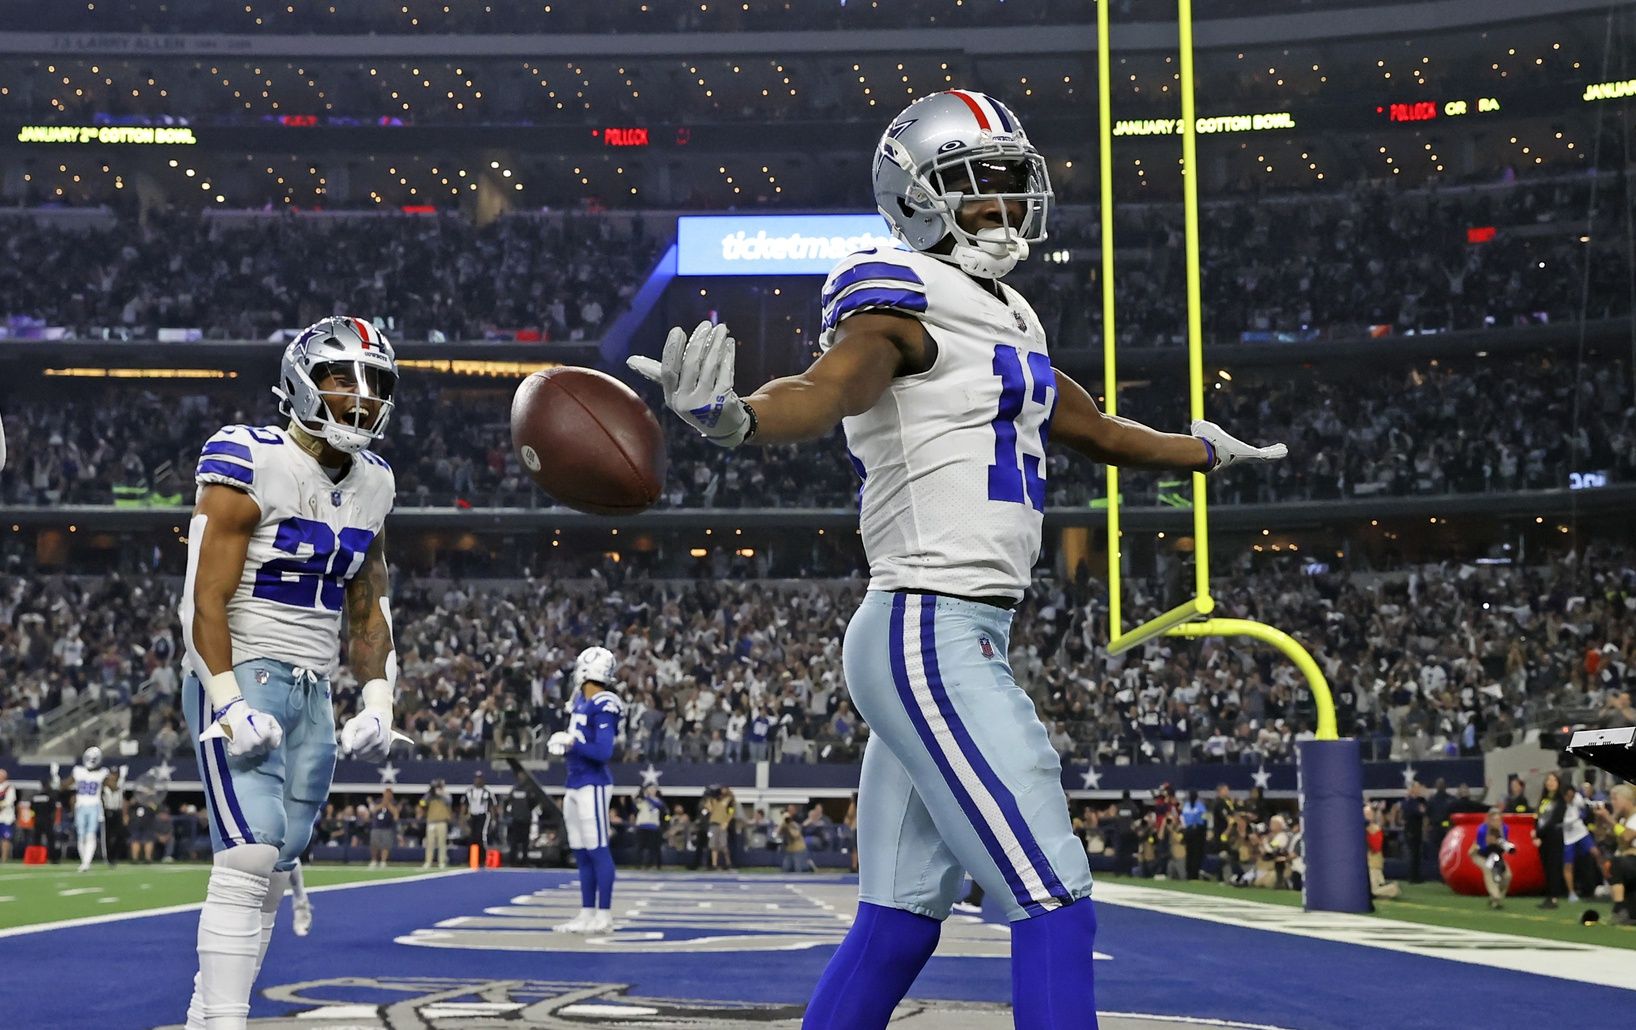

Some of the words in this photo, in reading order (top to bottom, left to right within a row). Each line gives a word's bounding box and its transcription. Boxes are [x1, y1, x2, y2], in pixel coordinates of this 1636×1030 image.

[1445, 101, 1467, 116] OR
[18, 126, 79, 143] JANUARY
[99, 127, 154, 144] COTTON
[1113, 119, 1176, 136] JANUARY
[1195, 115, 1251, 134] COTTON
[987, 343, 1058, 514] 13
[252, 516, 375, 612] 20
